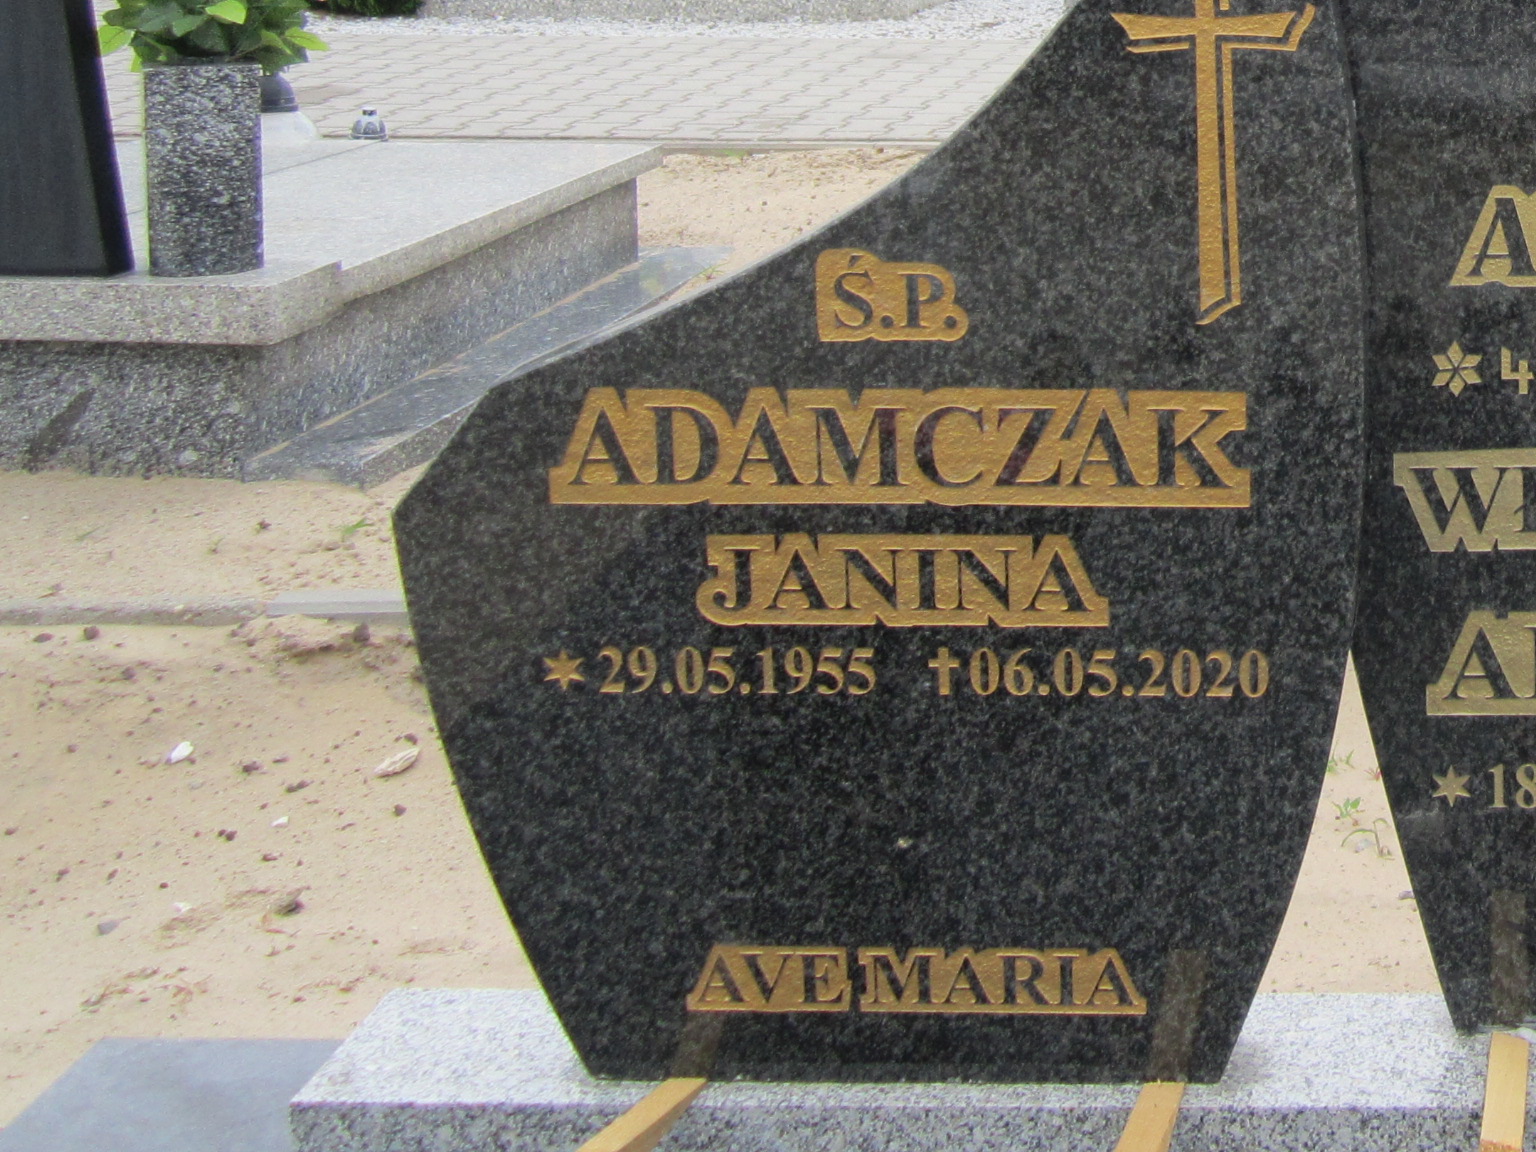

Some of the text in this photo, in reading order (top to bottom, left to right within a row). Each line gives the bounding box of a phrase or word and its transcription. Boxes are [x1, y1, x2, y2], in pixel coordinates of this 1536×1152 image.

[567, 403, 1237, 490] ADAMCZAK
[698, 545, 1097, 614] JANINA
[599, 644, 1271, 700] 29.05.1955 06.05.2020
[698, 950, 1141, 1007] AVE MARIA
